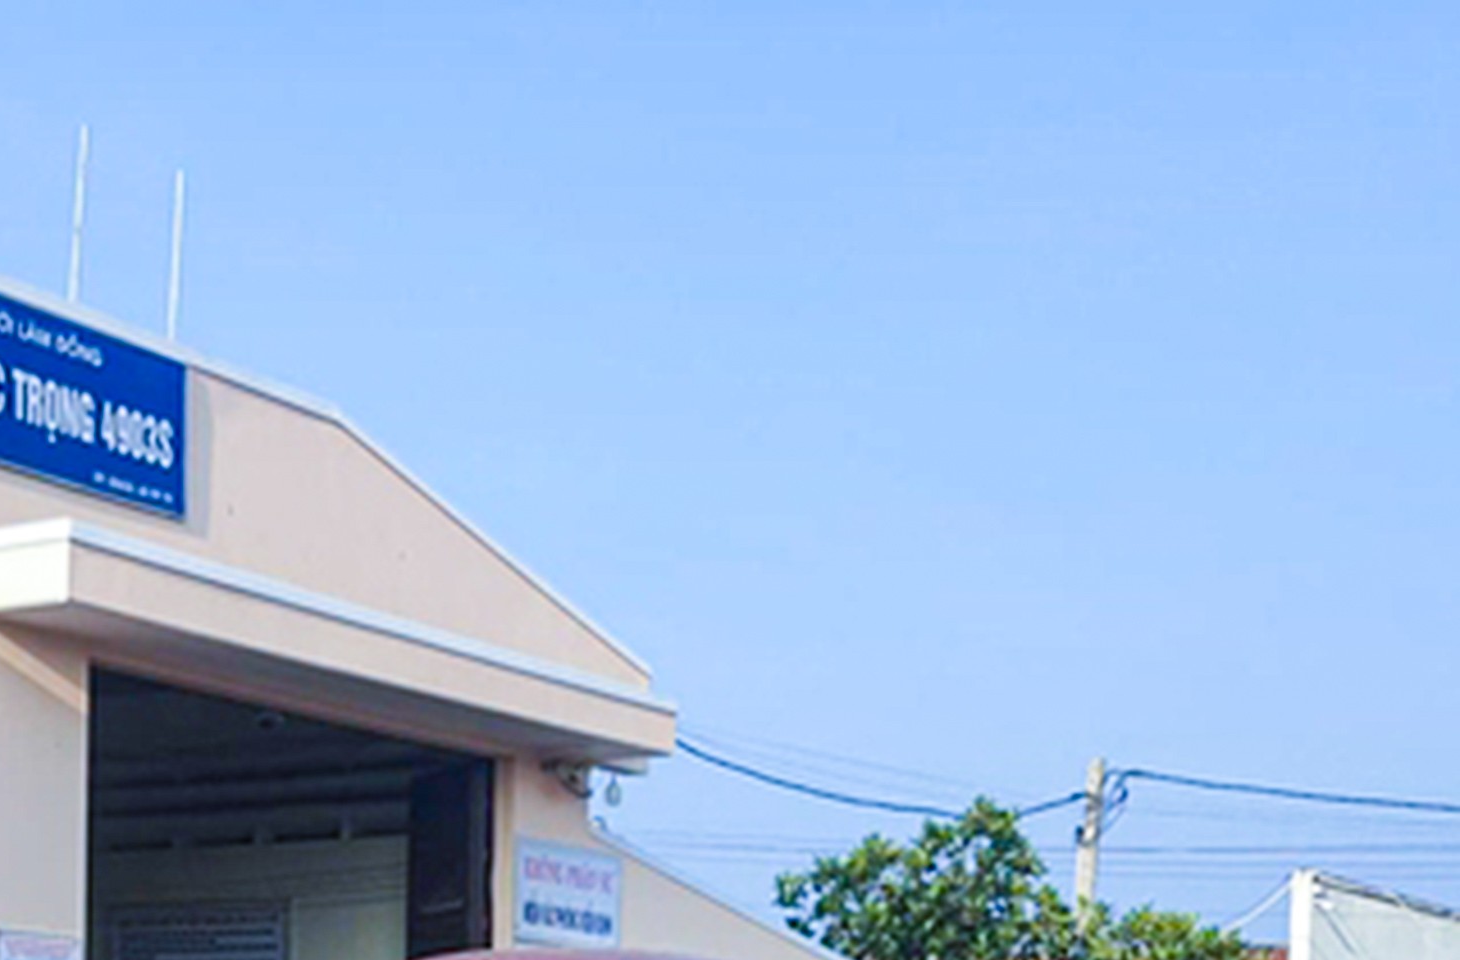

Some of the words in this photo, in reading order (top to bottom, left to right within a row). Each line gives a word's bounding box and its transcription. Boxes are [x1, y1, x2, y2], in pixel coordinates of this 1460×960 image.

[17, 320, 52, 348] LÂM
[54, 333, 103, 368] ĐỒNG
[11, 367, 97, 444] TRỌNG
[100, 400, 174, 469] 4903S
